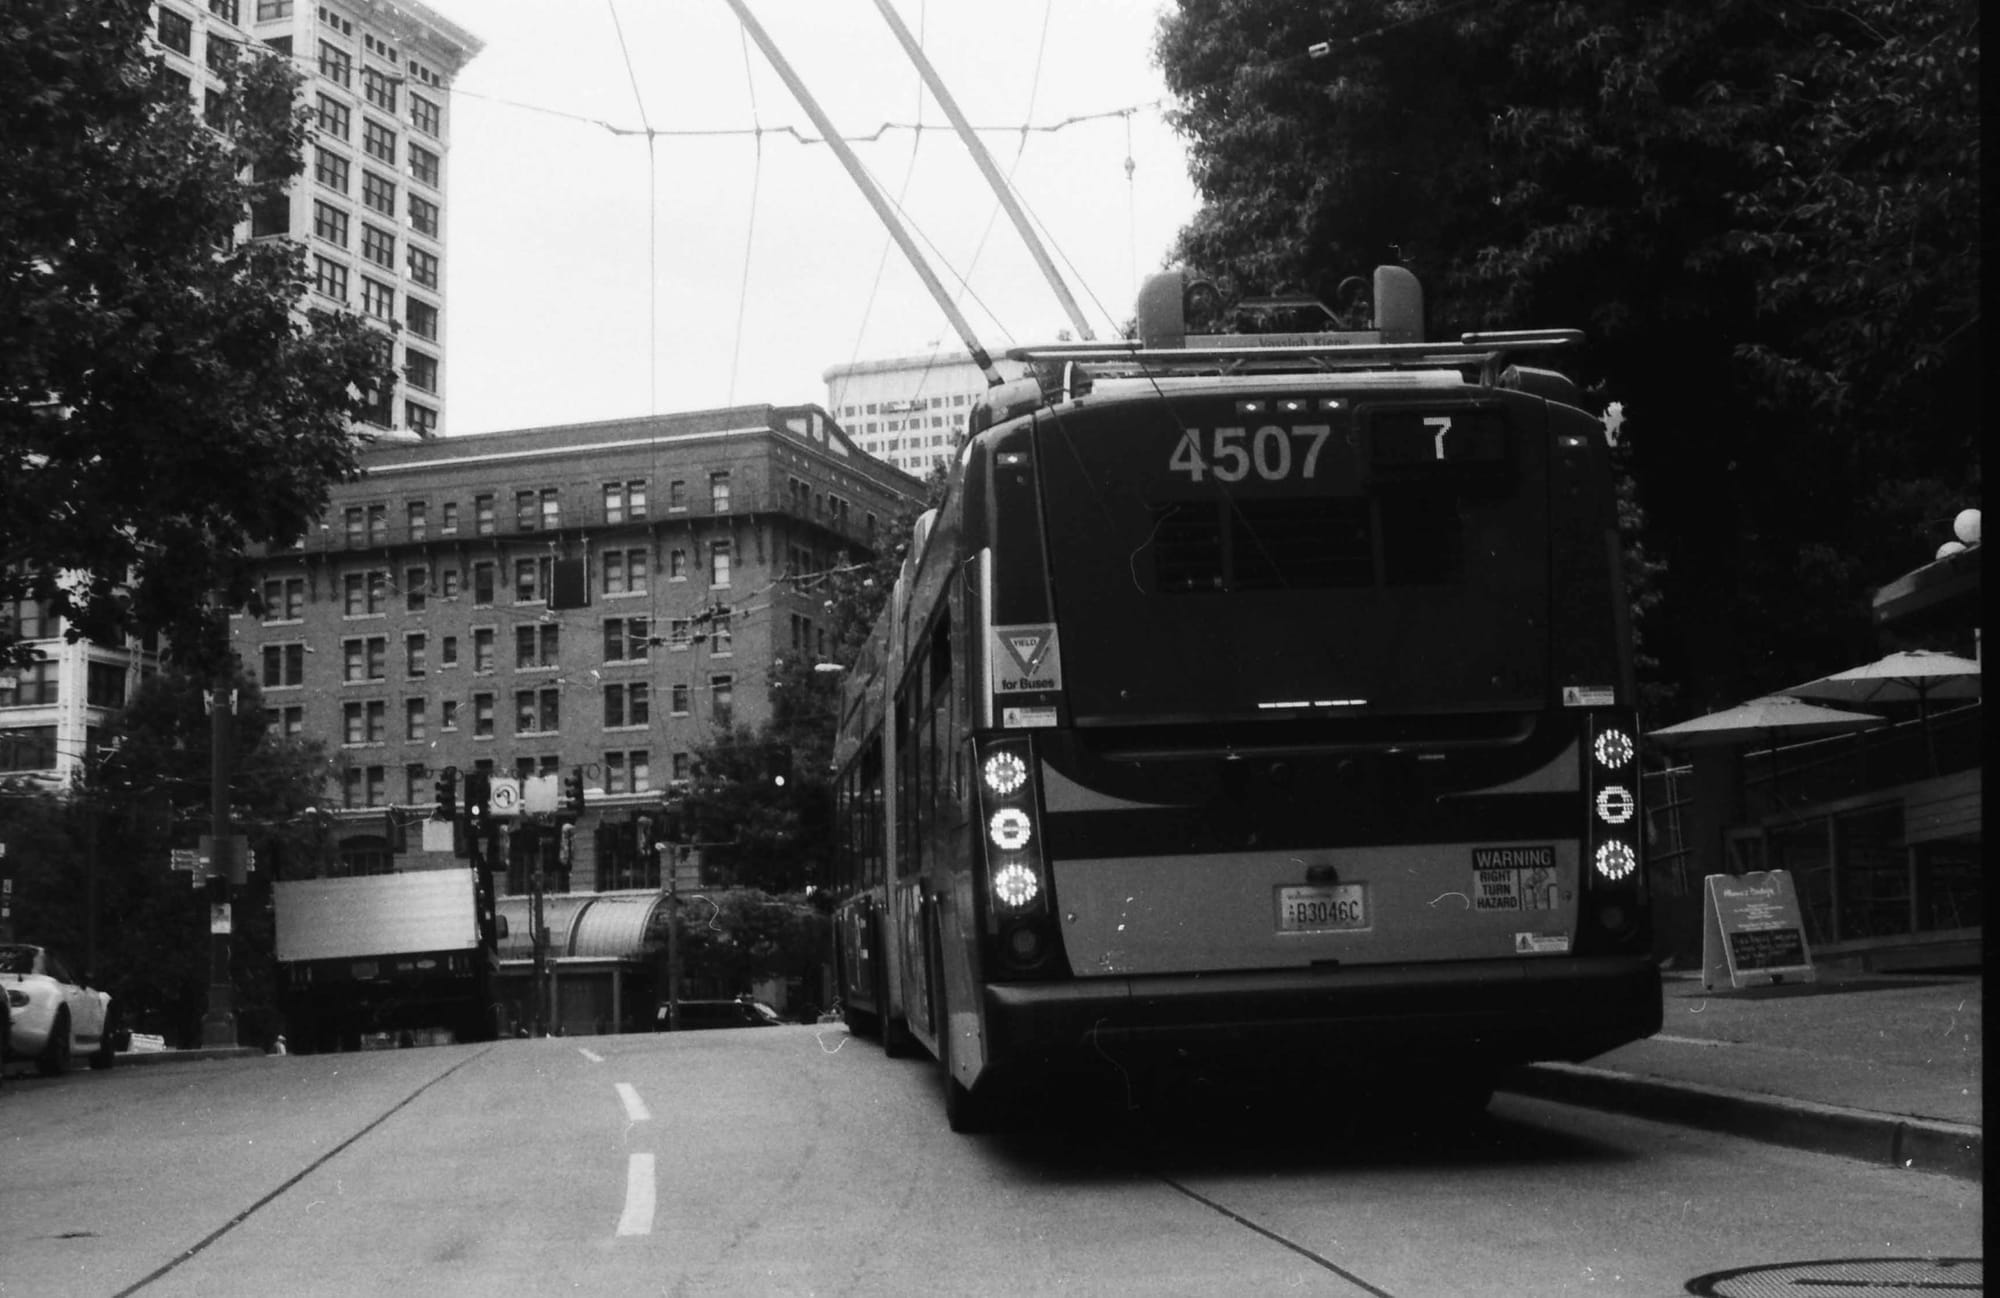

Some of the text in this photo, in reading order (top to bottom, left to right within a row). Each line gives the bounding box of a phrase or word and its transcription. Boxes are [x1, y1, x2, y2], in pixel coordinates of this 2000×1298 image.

[1423, 417, 1451, 459] 7
[1169, 425, 1330, 482] 4507
[1014, 639, 1036, 647] YIELD
[1002, 678, 1055, 690] for Buses
[1476, 849, 1551, 868] WARNING
[1480, 871, 1511, 882] RIGHT
[1482, 884, 1510, 895] TURN
[1477, 896, 1517, 908] HAZARD
